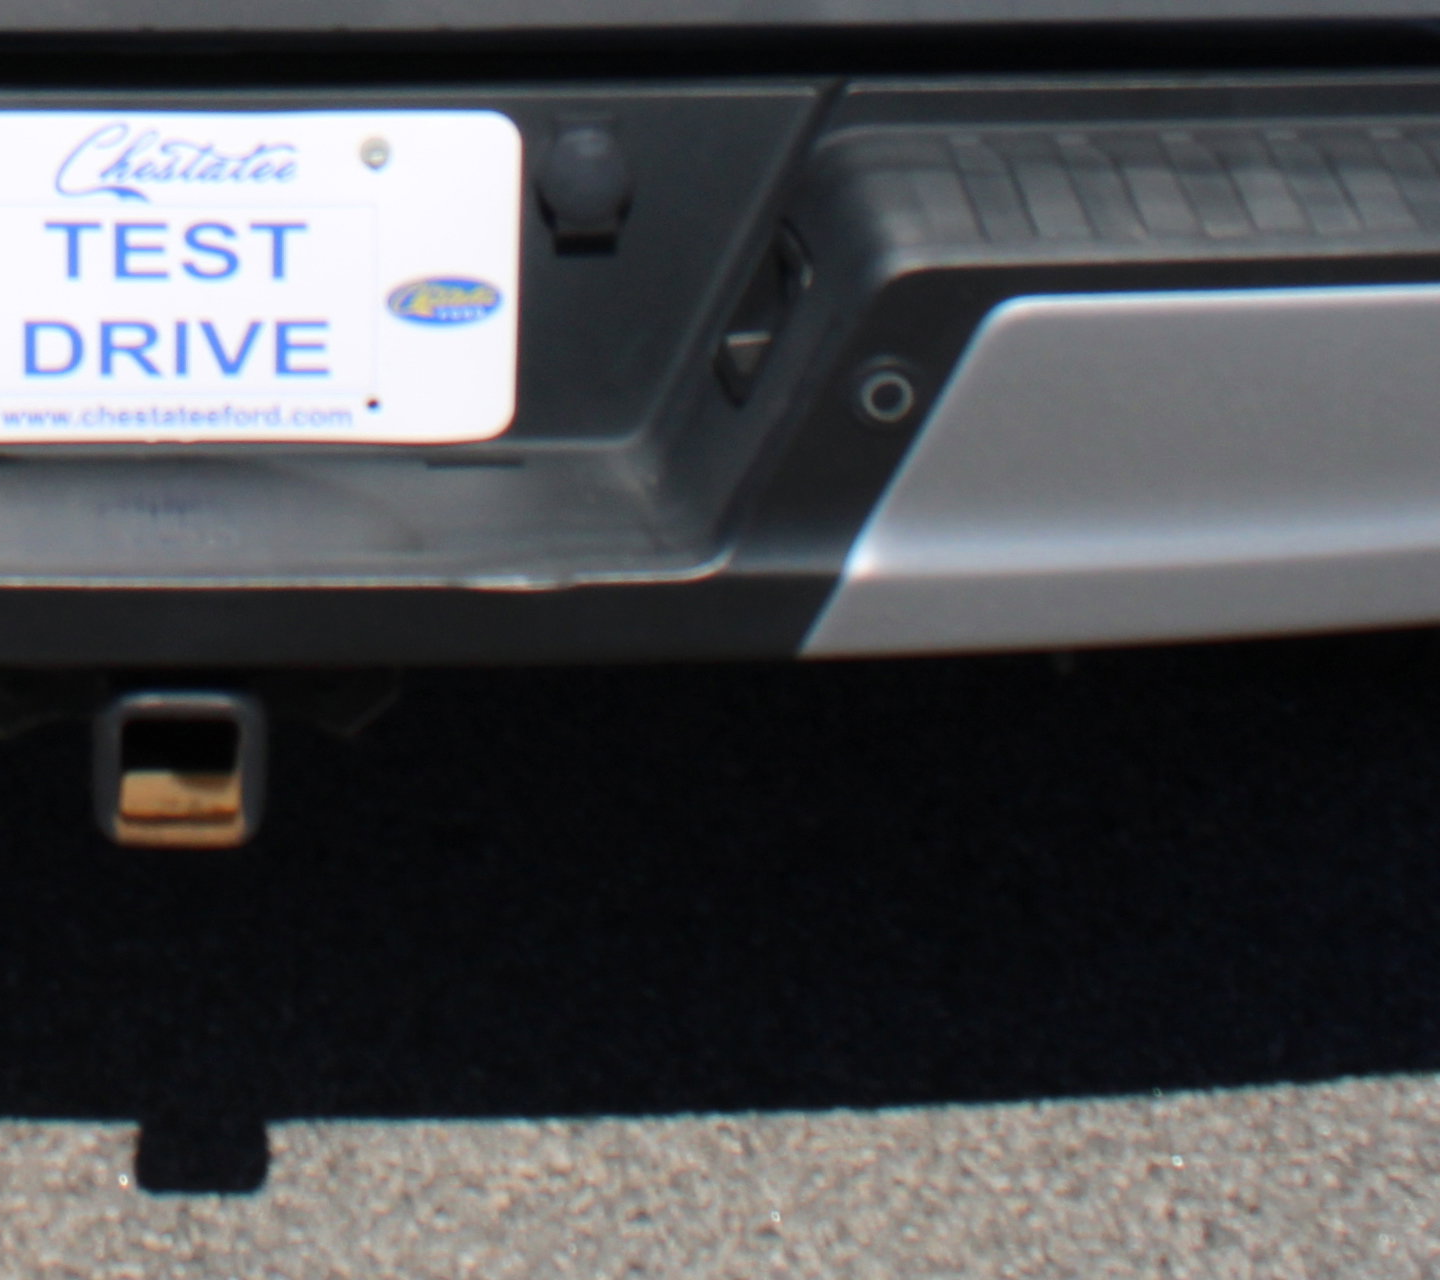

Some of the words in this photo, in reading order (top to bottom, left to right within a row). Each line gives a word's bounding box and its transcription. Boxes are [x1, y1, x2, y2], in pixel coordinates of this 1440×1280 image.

[55, 121, 300, 202] Chestatee
[44, 220, 308, 281] TEST
[23, 320, 331, 377] DRIVE
[2, 402, 354, 430] www.chestateeford.com
